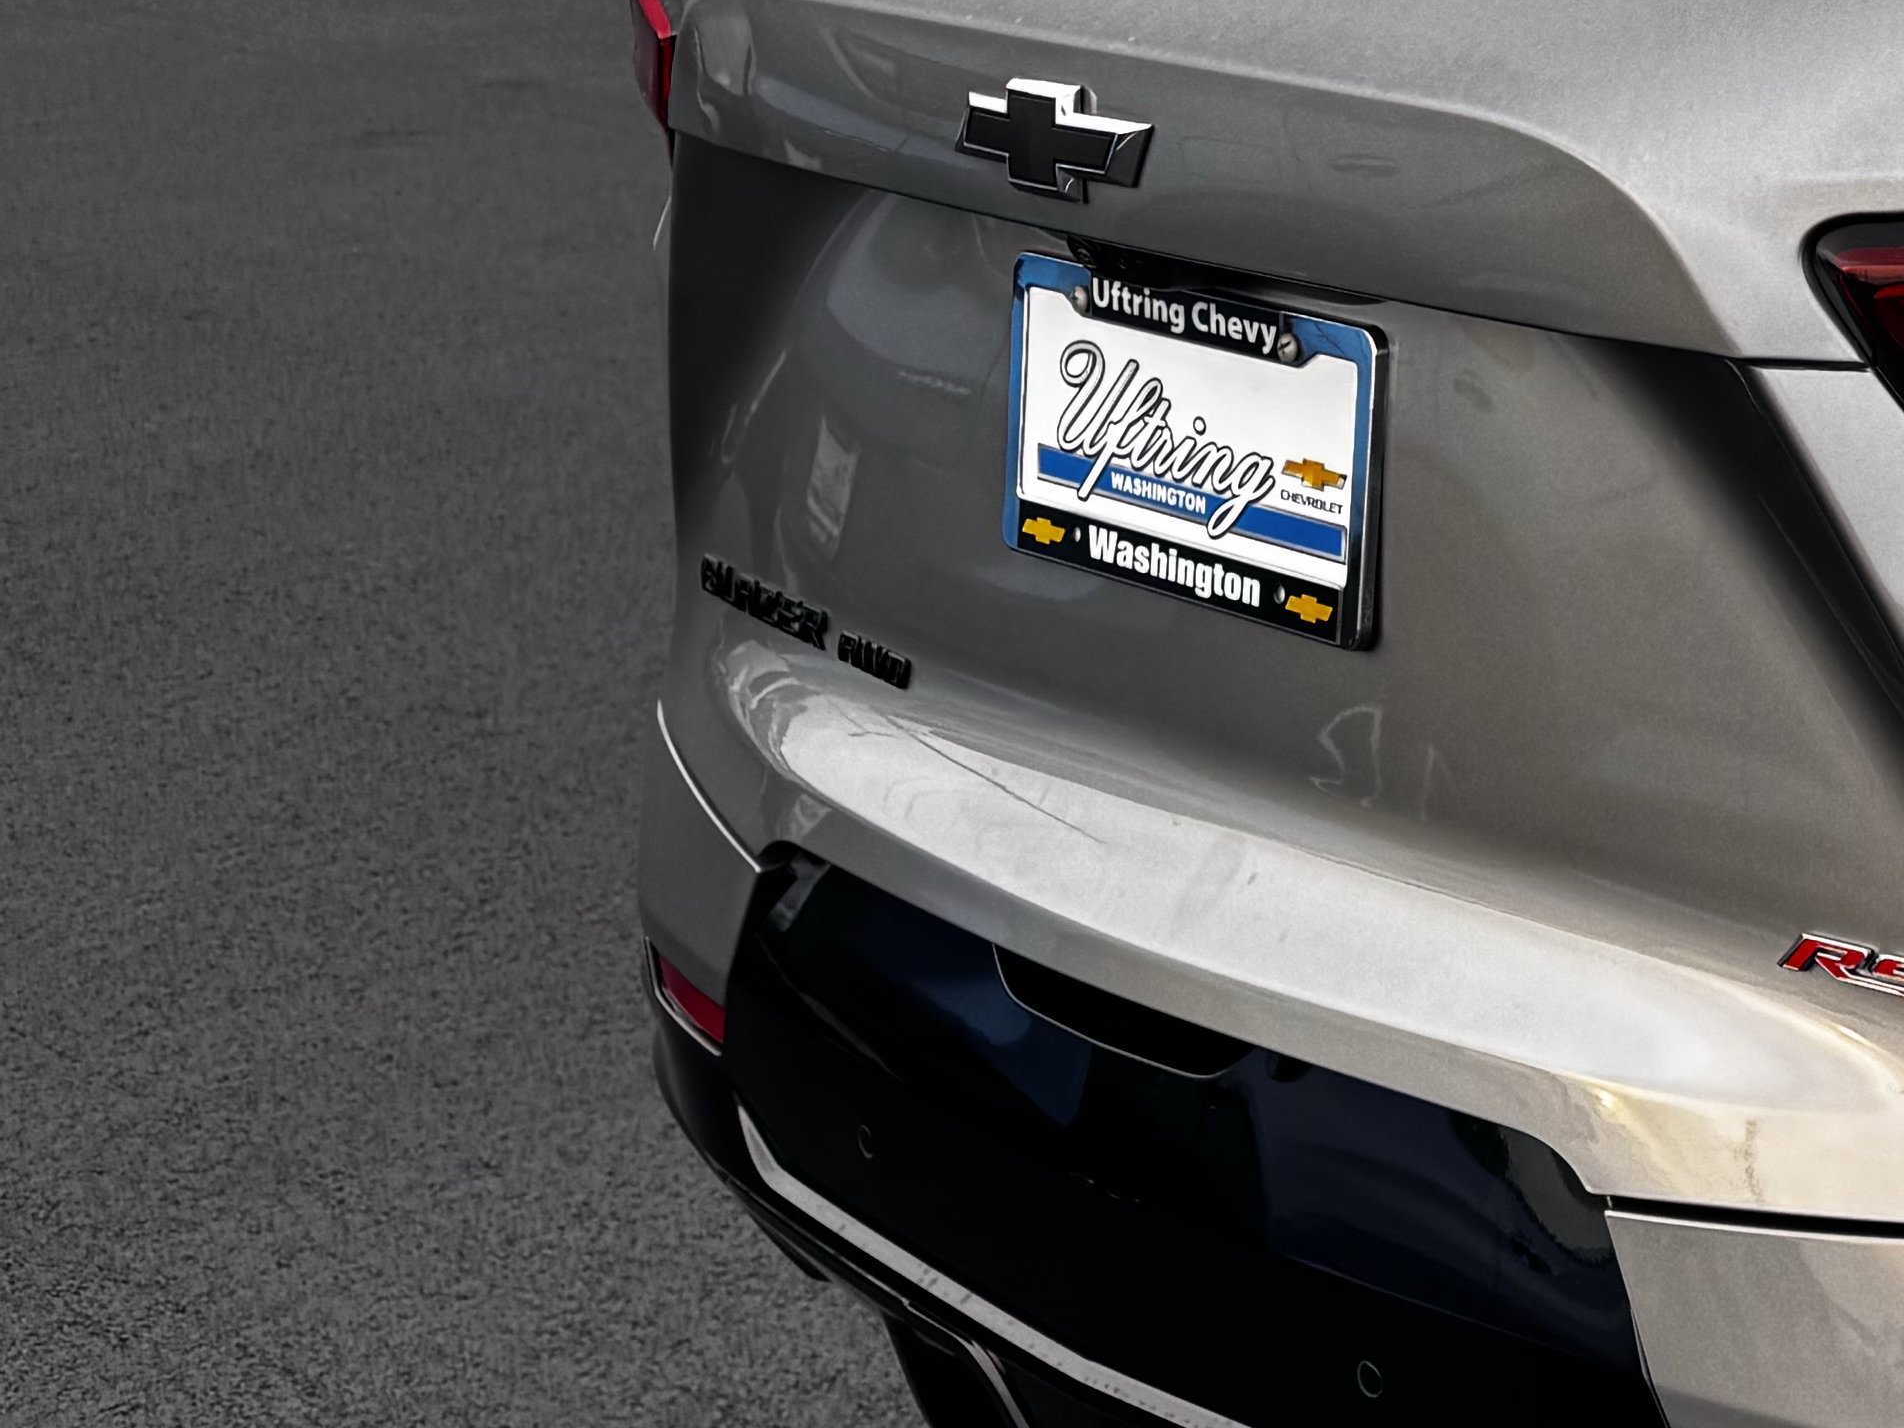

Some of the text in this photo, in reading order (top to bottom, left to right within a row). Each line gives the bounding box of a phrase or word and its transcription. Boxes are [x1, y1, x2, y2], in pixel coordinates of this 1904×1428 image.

[1092, 277, 1278, 354] Uftring Chevy
[1056, 339, 1275, 538] Uftring
[1110, 472, 1206, 515] WASHINGTON
[1280, 488, 1344, 516] CHEVROLET
[1088, 525, 1261, 608] Washington
